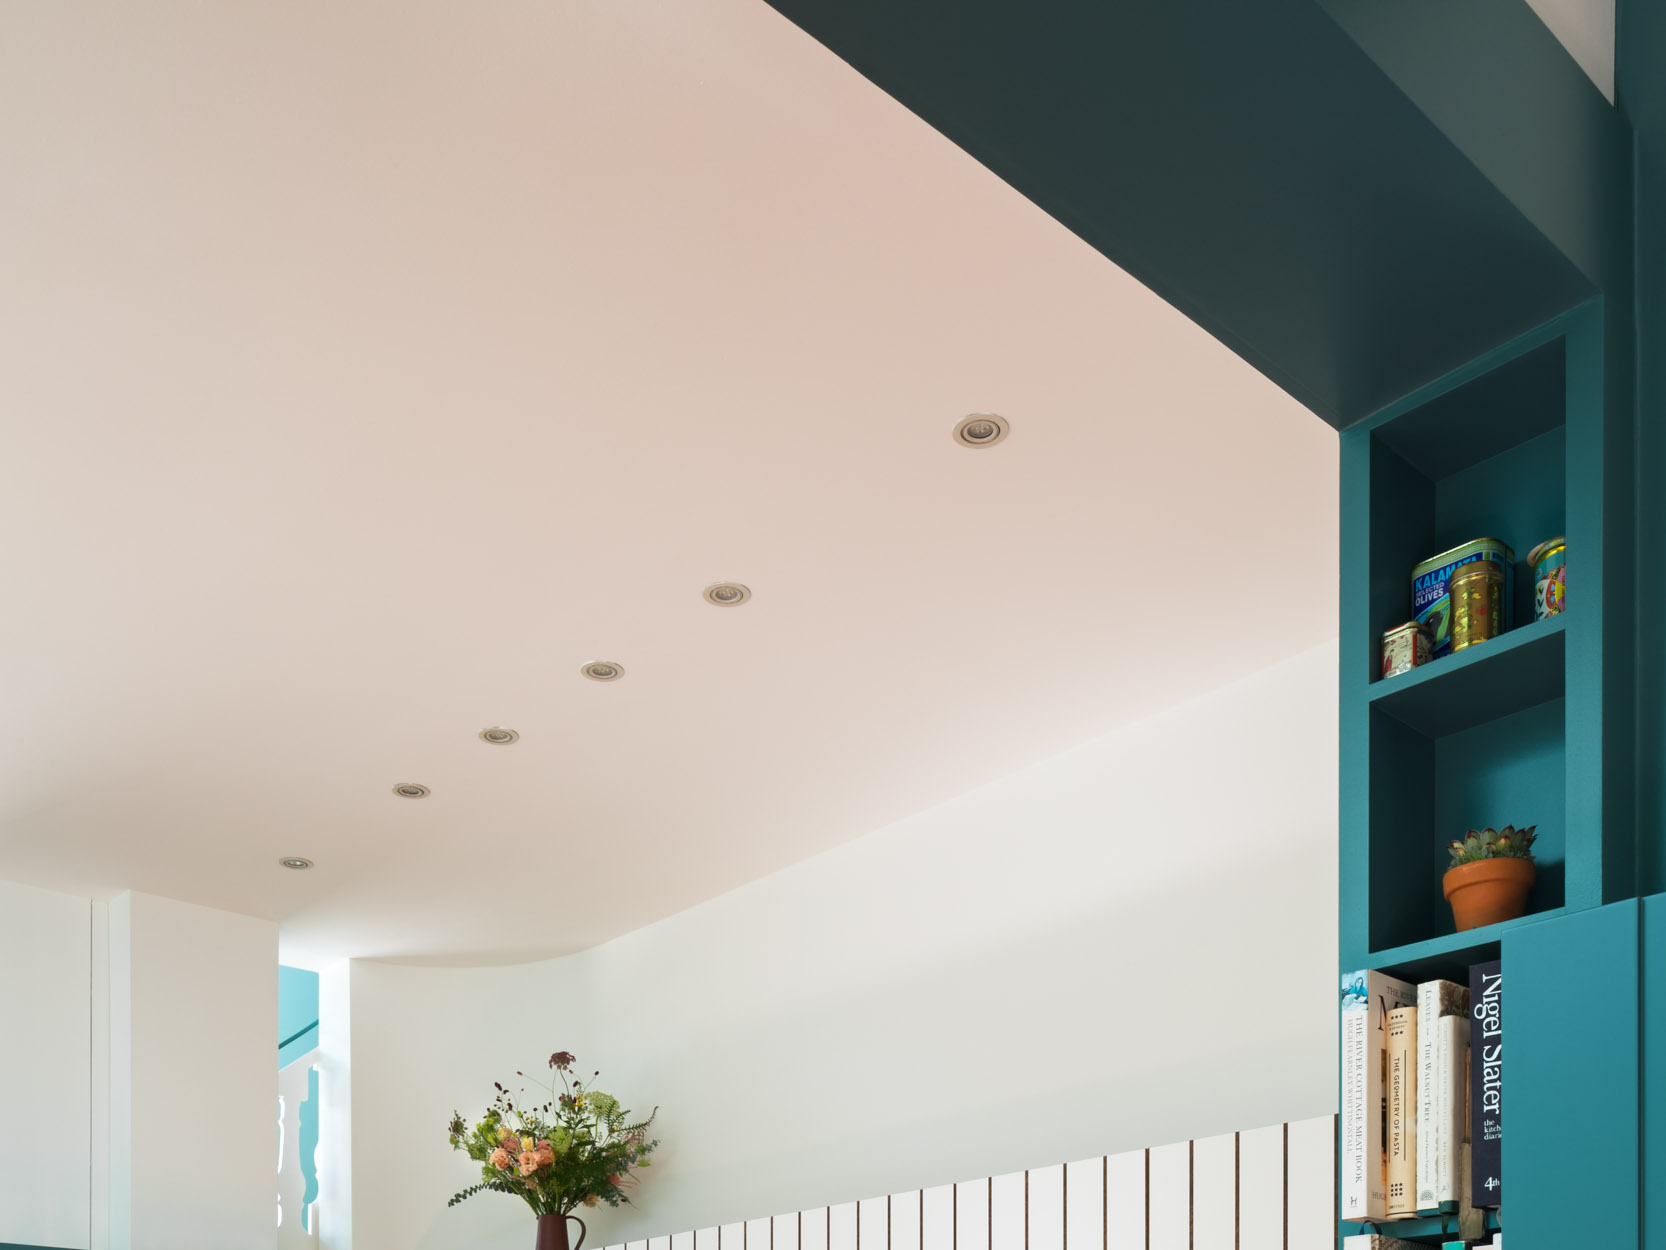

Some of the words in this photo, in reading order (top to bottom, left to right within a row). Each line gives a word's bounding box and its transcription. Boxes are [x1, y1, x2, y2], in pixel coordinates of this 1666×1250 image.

[1415, 587, 1444, 607] OLIVES
[1474, 973, 1502, 1039] Nigel
[1355, 1015, 1363, 1038] THE
[1355, 1040, 1363, 1071] RIVER
[1483, 1044, 1502, 1114] Slater
[1355, 1073, 1363, 1121] COTTAGE
[1424, 1100, 1432, 1122] TREE
[1355, 1125, 1363, 1153] MEAT
[1393, 1119, 1400, 1131] OF
[1355, 1154, 1363, 1184] BOOK
